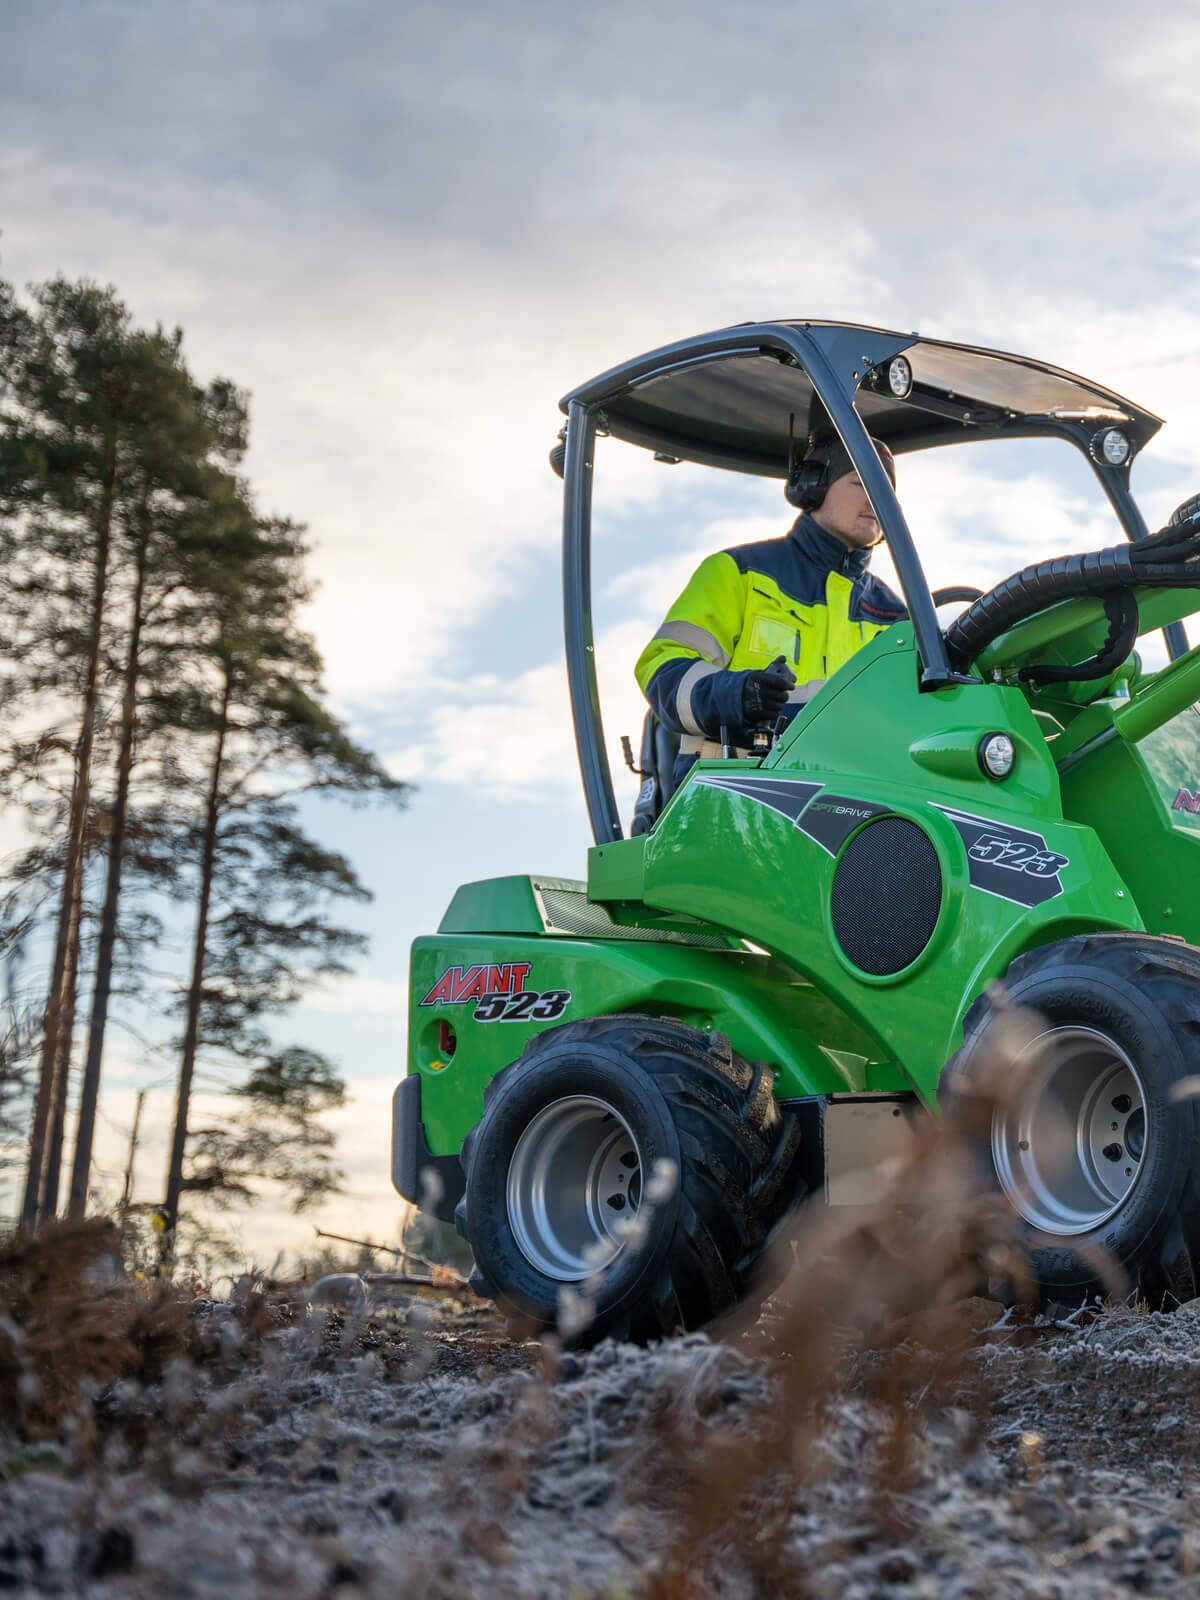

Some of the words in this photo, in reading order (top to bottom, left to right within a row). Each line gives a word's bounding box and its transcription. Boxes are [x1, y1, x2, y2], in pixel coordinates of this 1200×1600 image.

[808, 803, 873, 819] OPTIDRIVE
[968, 833, 1070, 878] 523
[418, 961, 533, 1007] AVANT
[472, 989, 572, 1023] 523
